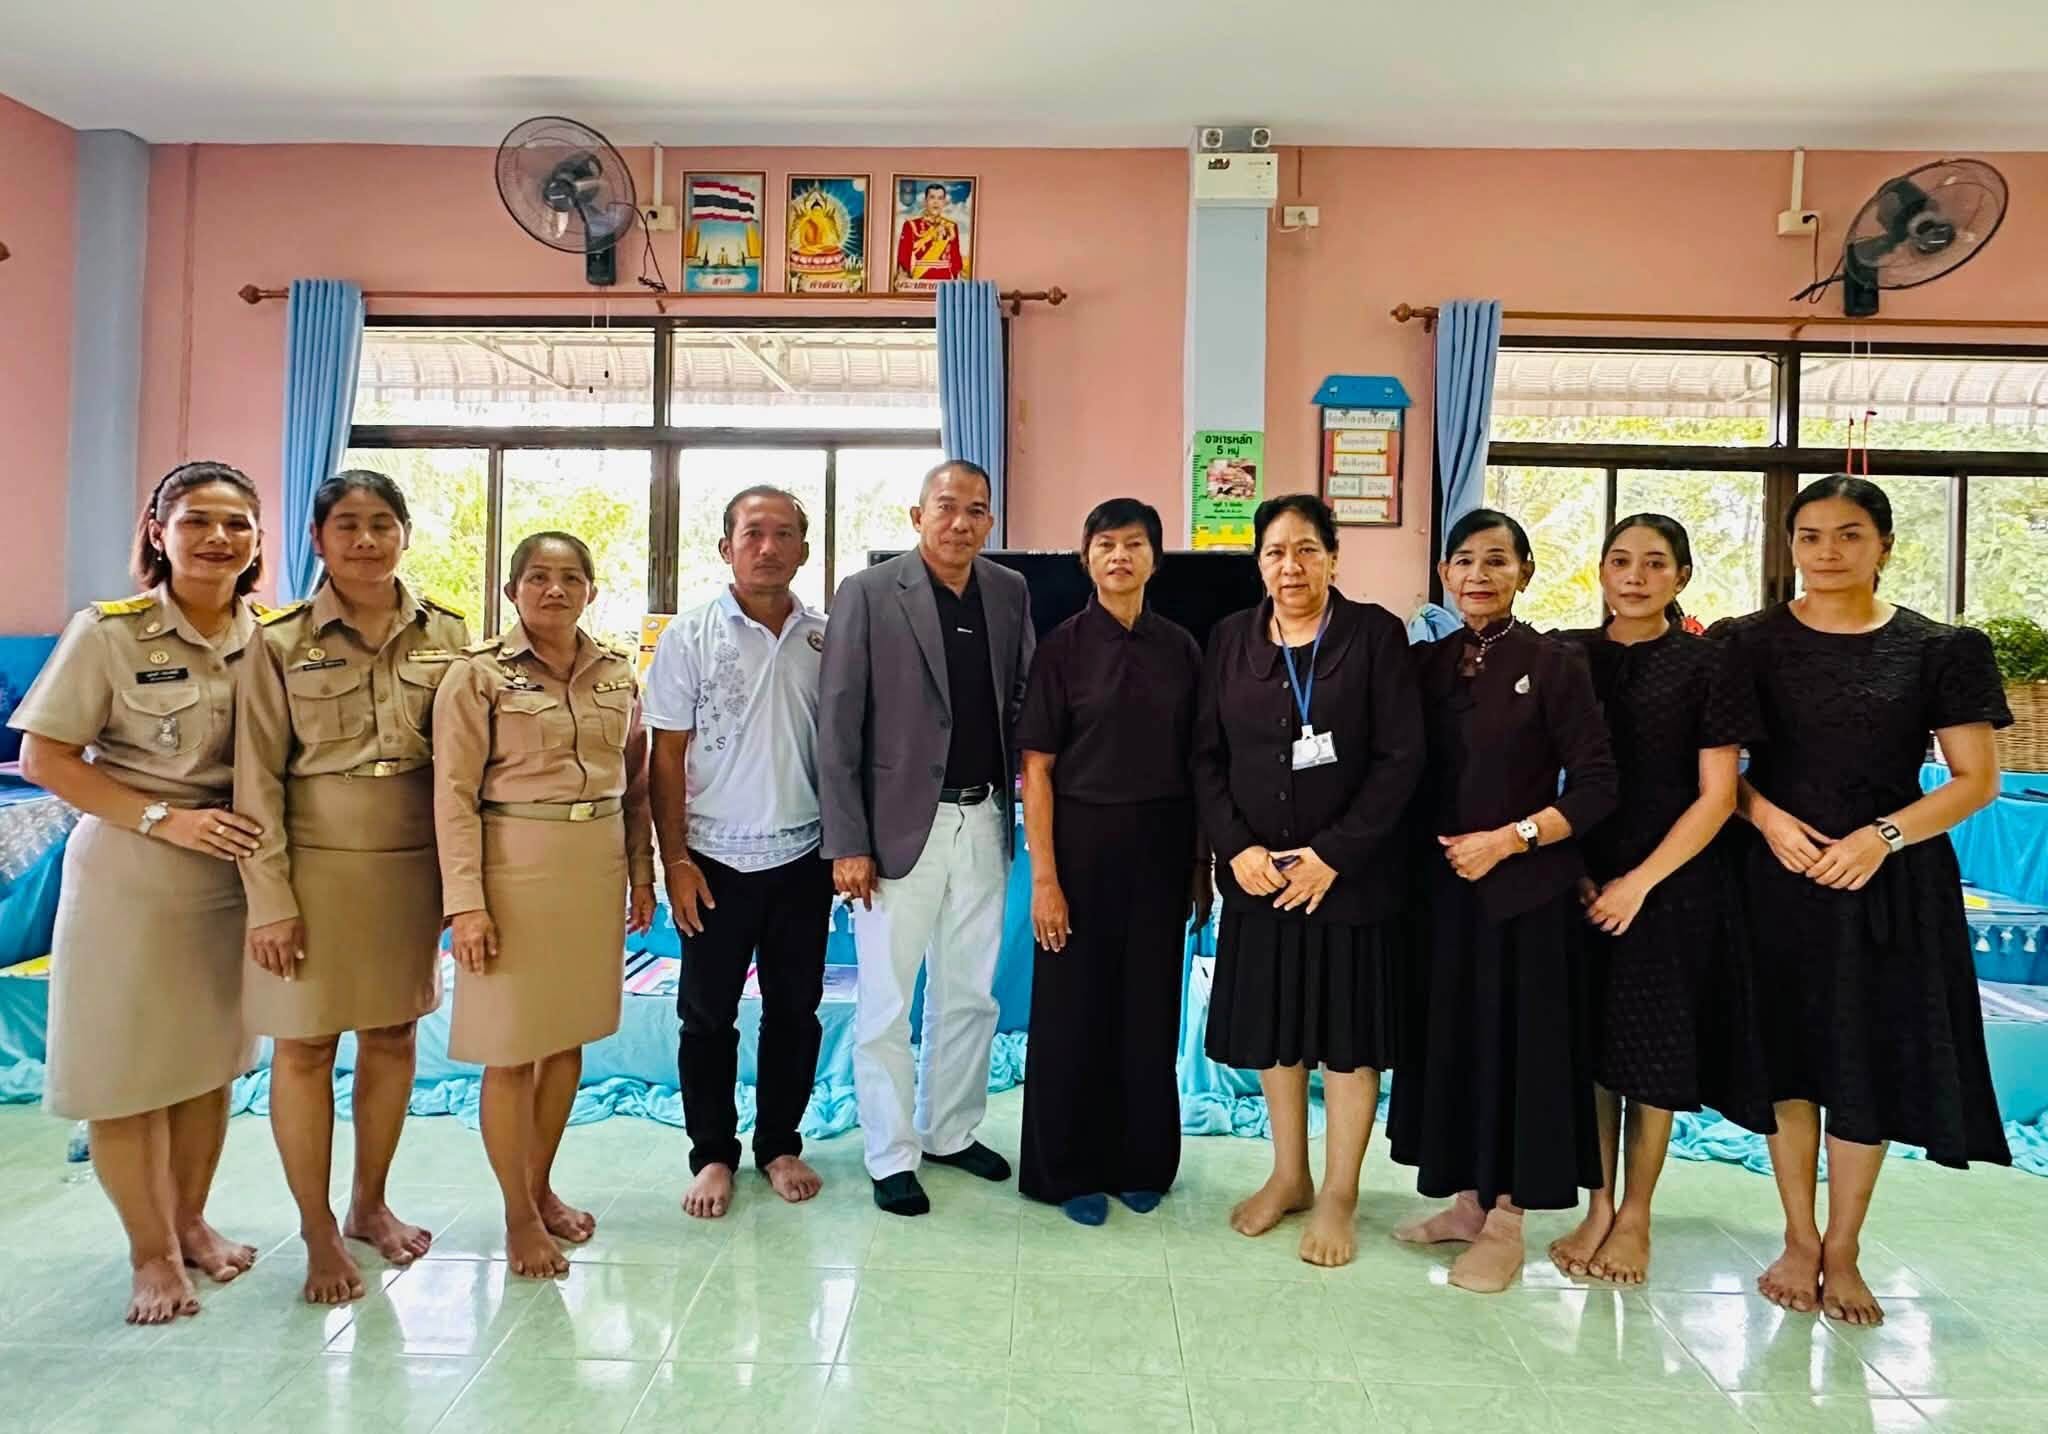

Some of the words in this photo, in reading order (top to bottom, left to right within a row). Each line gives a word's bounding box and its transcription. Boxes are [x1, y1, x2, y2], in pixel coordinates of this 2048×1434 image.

[1205, 434, 1253, 444] อาหารหลัก
[1217, 445, 1224, 455] 5
[1227, 445, 1240, 458] หมู่
